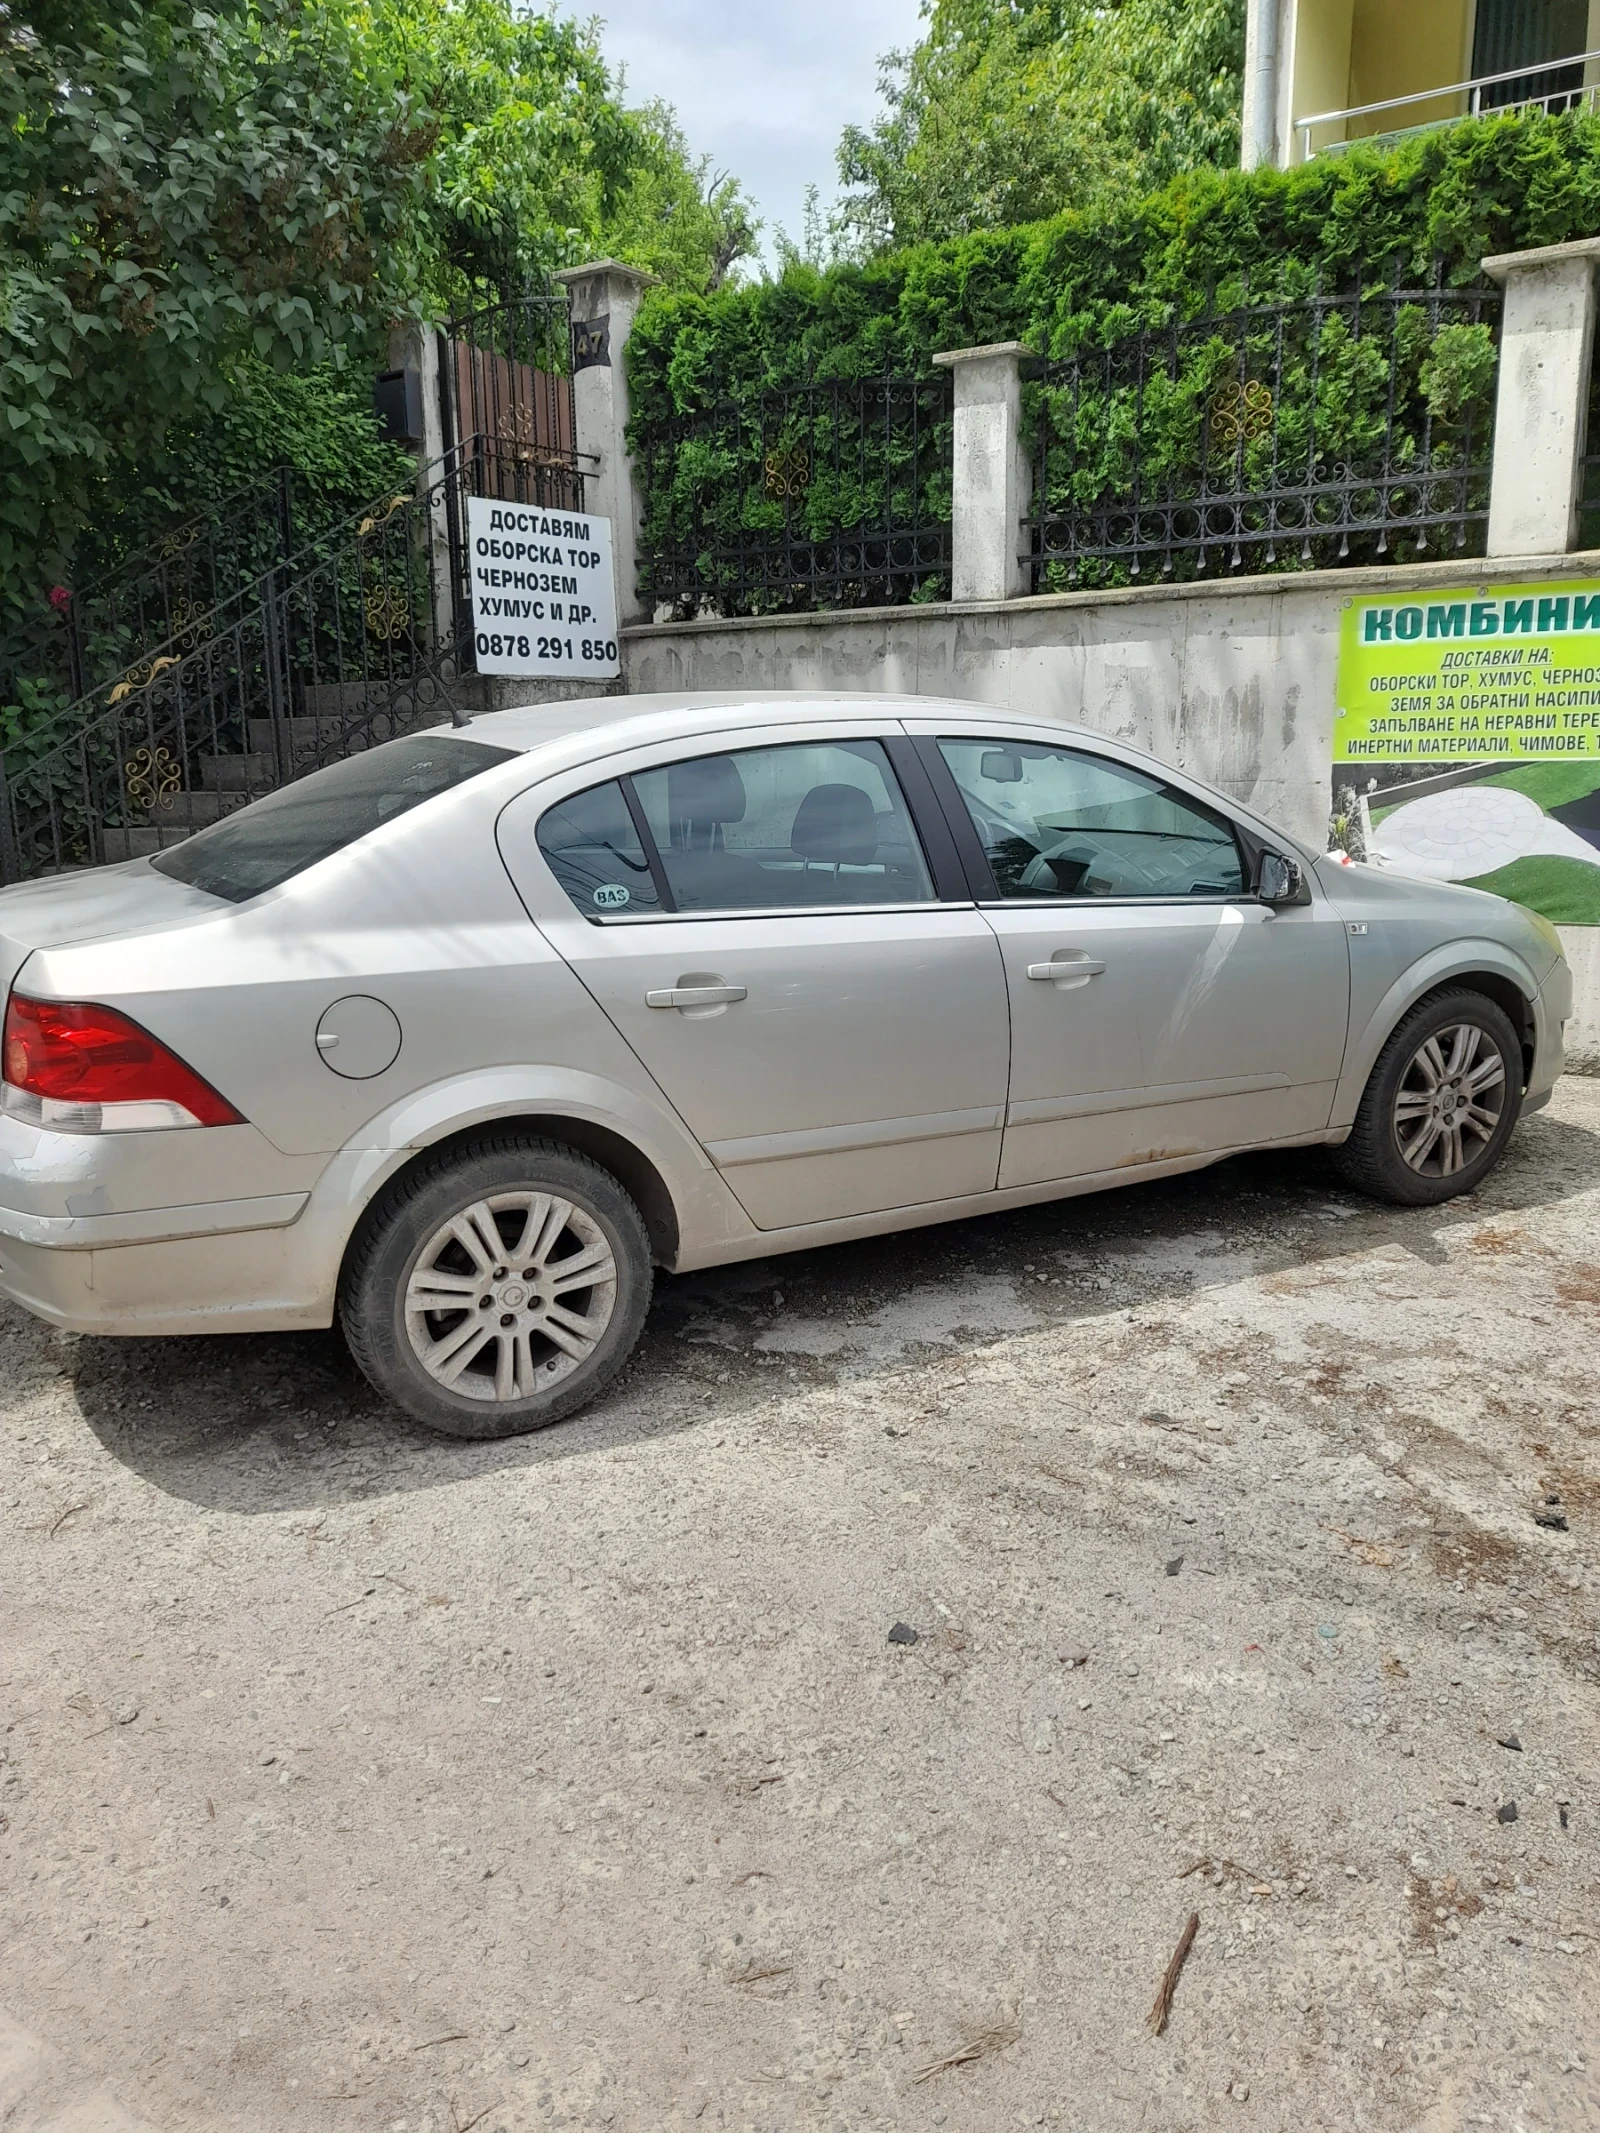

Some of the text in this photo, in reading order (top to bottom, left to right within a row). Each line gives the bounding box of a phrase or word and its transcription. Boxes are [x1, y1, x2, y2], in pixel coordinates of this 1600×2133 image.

[576, 330, 602, 355] 47
[490, 509, 590, 541] ДОСТАВЯМ
[476, 537, 601, 569] ОБОРСКА ТОР
[477, 567, 578, 595] ЧЕРНОЗЕМ
[479, 596, 597, 626] ХУМУС И ДР.
[1364, 594, 1600, 641] КОМБИНИ
[476, 632, 617, 661] 0878 291 850
[1441, 648, 1554, 670] ДОСТАВКИ НА:
[1370, 675, 1437, 691] ОБОРСКИ
[1442, 673, 1473, 690] ТОР,
[1478, 670, 1537, 688] ХУМУС,
[1391, 690, 1600, 712] ЗЕМЯ ЗА ОБРАТНИ НАСИПИ
[1369, 712, 1600, 733] ЗАПЪЛВАНЕ НА НЕРАВНИ ТЕРЕ
[1348, 739, 1413, 754] ИНЕРТНИ
[1418, 737, 1513, 753] МАТЕРИАЛИ,
[1519, 735, 1590, 753] ЧИМОВЕ,
[597, 889, 627, 904] BAS
